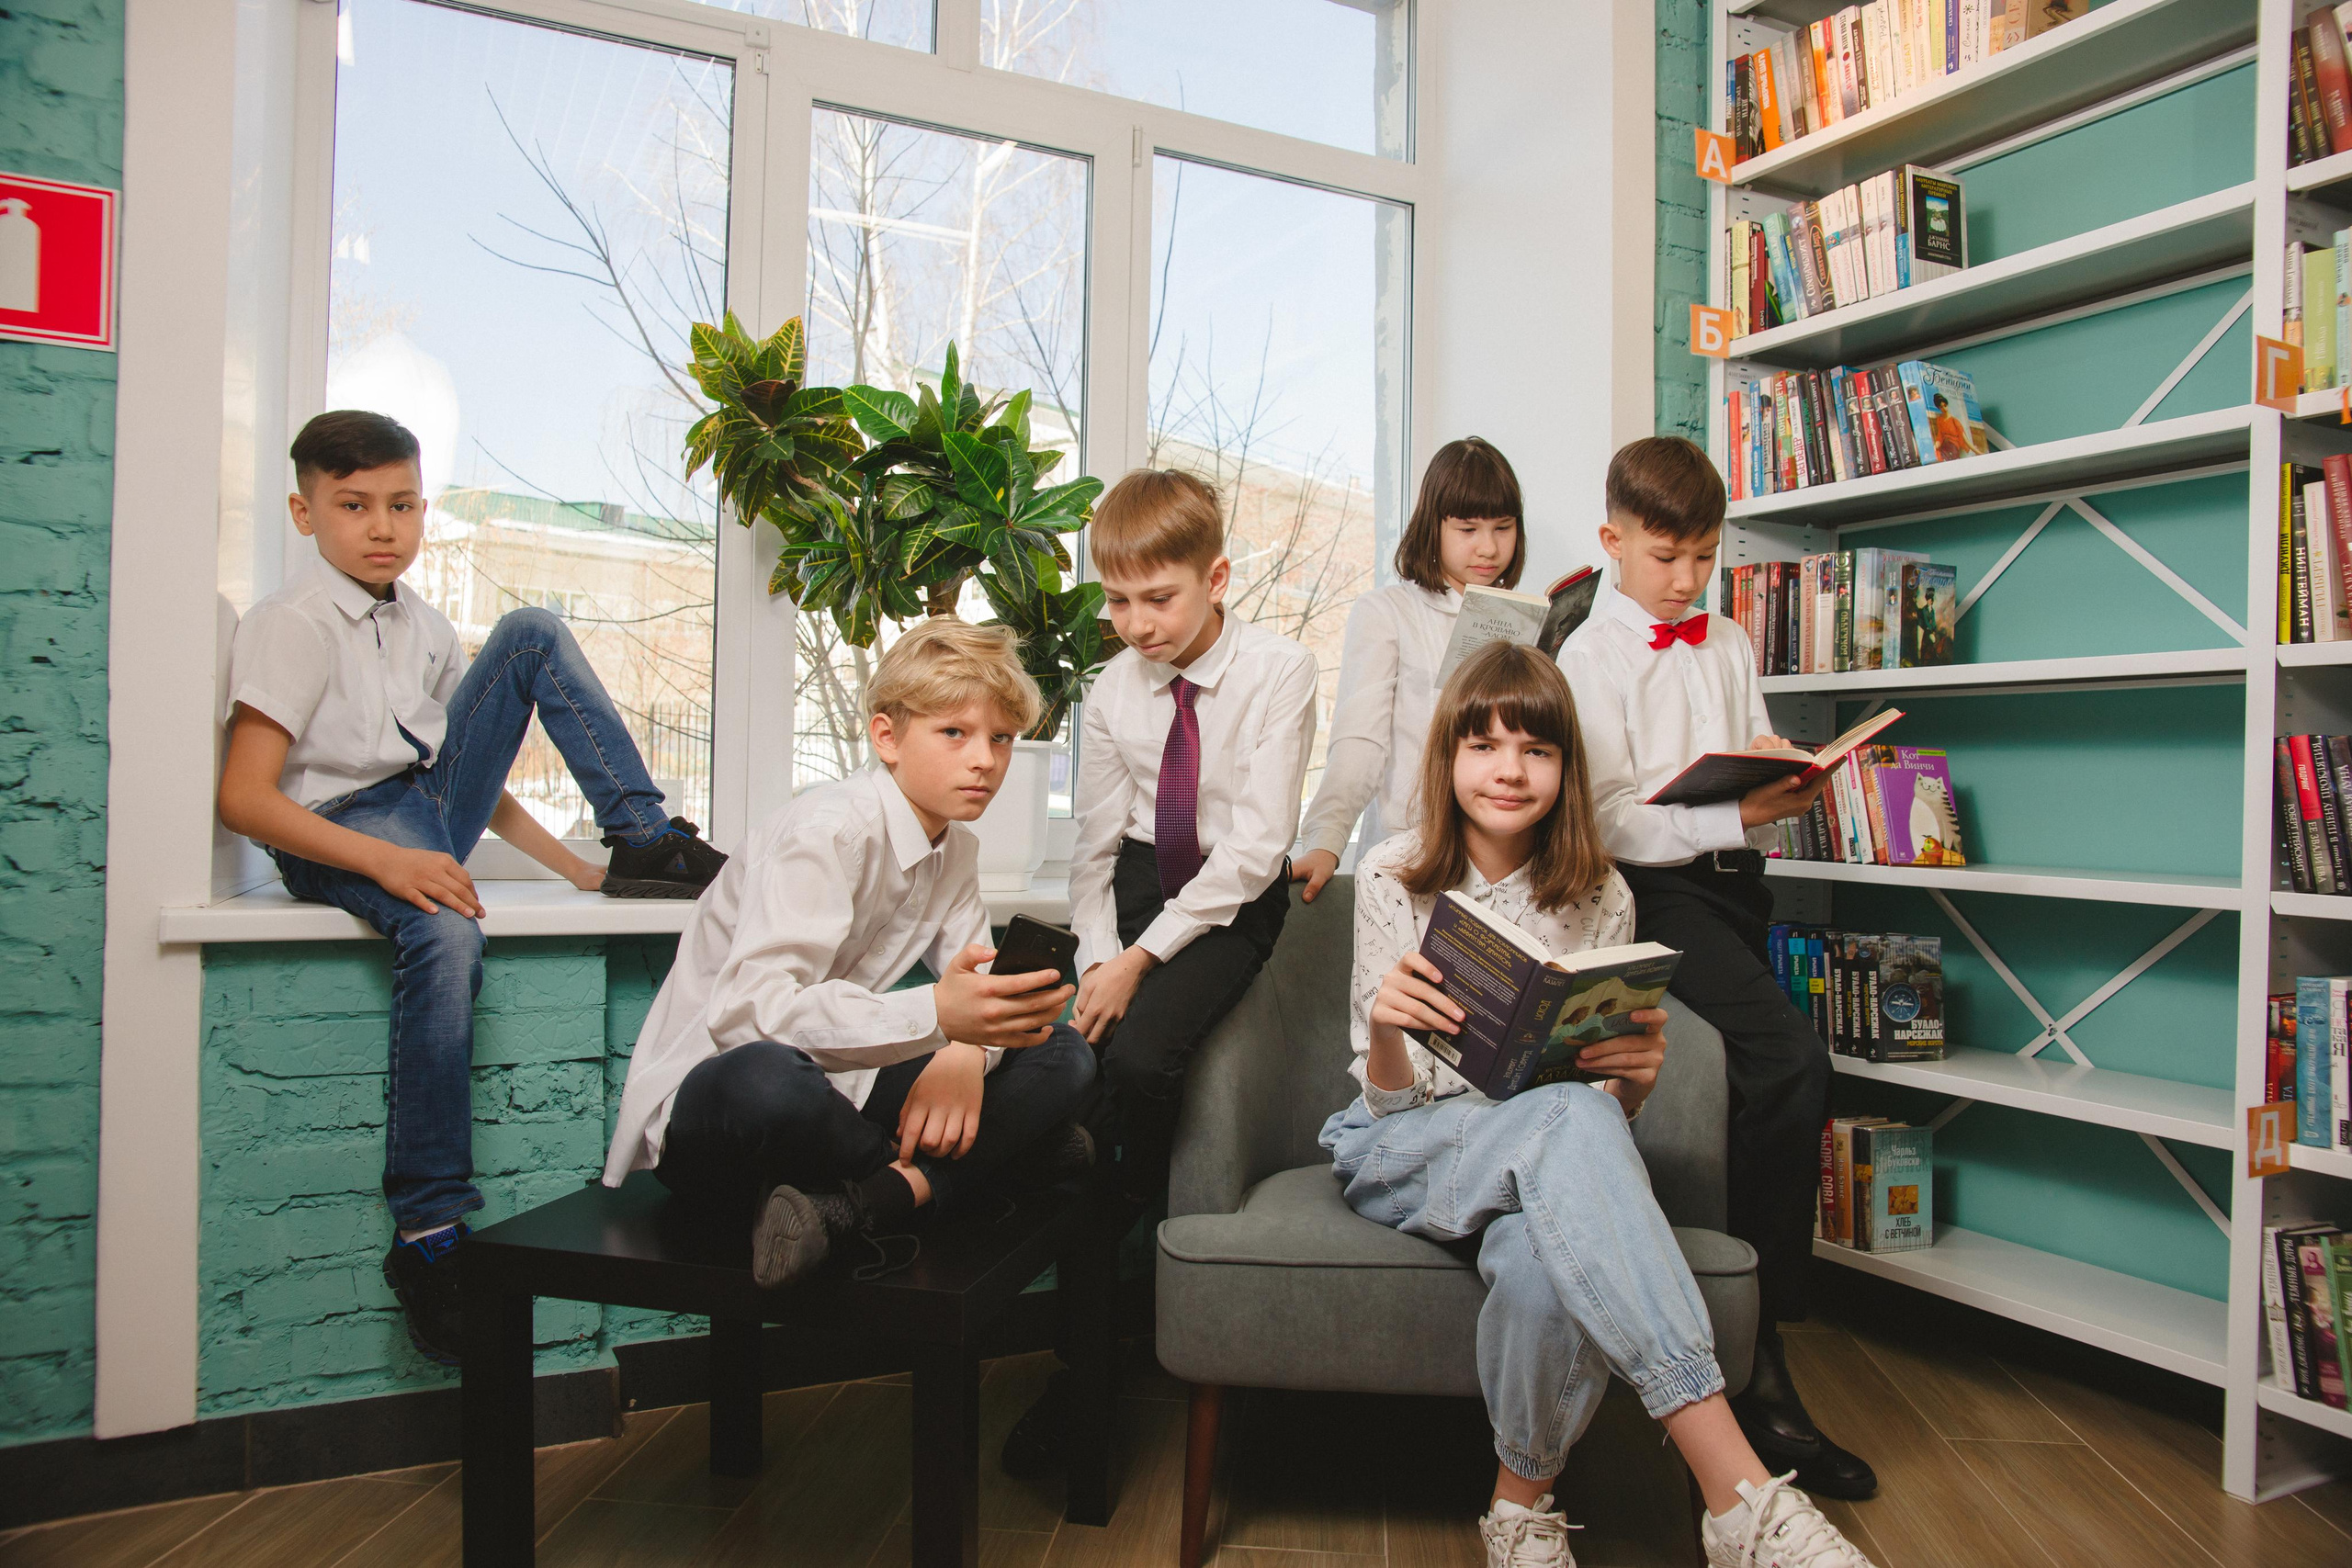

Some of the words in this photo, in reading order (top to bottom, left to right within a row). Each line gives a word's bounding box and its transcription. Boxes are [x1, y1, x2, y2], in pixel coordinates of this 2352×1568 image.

[1702, 138, 1727, 178] А
[1921, 184, 1952, 195] ЛИТЕРАТУРНЫХ
[1928, 190, 1946, 198] ПРЕМИЙ
[1937, 182, 1958, 190] МИРОВЫХ
[1928, 240, 1951, 251] БАРНС
[1700, 311, 1723, 351] Б
[2267, 346, 2289, 400] Г
[1777, 408, 1785, 436] КОНЕЦ
[2280, 533, 2290, 575] ДЖУНГЛИ
[2296, 547, 2306, 572] НИЛ
[2313, 559, 2324, 608] ГИЛБЕРТ
[2298, 575, 2310, 626] ГЕЙМАН
[1487, 618, 1512, 628] АННА
[1891, 761, 1902, 770] да
[1904, 761, 1935, 771] Винчи
[1902, 750, 1920, 760] Кот
[2299, 763, 2311, 791] ГОЛДРИНГ
[2312, 742, 2330, 799] ПРОКЛЯТИЯ
[1814, 800, 1822, 822] БРАУН
[2322, 802, 2336, 835] ПЛЕНУ
[1818, 822, 1826, 849] САНДРА
[2287, 803, 2297, 829] РОБЕРТ
[2292, 831, 2305, 873] ГРЕЙСМИТ
[2311, 834, 2324, 863] ЗВАЛИ
[2316, 864, 2326, 883] ЕВА
[1580, 917, 1594, 944] CUTE
[1496, 937, 1528, 963] ПОКЛОННИКОВ
[1534, 1000, 1552, 1021] ИСХОД
[1835, 968, 1843, 1035] БУАЛО-НАРСЕЖАК
[1852, 971, 1860, 1039] БУАЛО-НАРСЕЖАК
[1869, 970, 1879, 1039] БУАЛО-НАРСЕЖАК
[1894, 1030, 1943, 1040] НАРСЕЖАК
[1911, 1020, 1942, 1030] БУАЛО-
[1516, 1050, 1533, 1075] ГОВАРД
[1892, 1145, 1916, 1156] Чарльз
[2255, 1111, 2282, 1169] Д
[1888, 1156, 1919, 1168] Буковски
[1822, 1176, 1834, 1203] СОВА
[1885, 1230, 1890, 1239] С
[1891, 1225, 1921, 1238] ВЕТЧИНОЙ
[1896, 1217, 1911, 1227] ХЛЕБ
[2266, 1258, 2278, 1294] ТЕМНЫЕ
[2285, 1265, 2300, 1303] ТЕМНЫЕ
